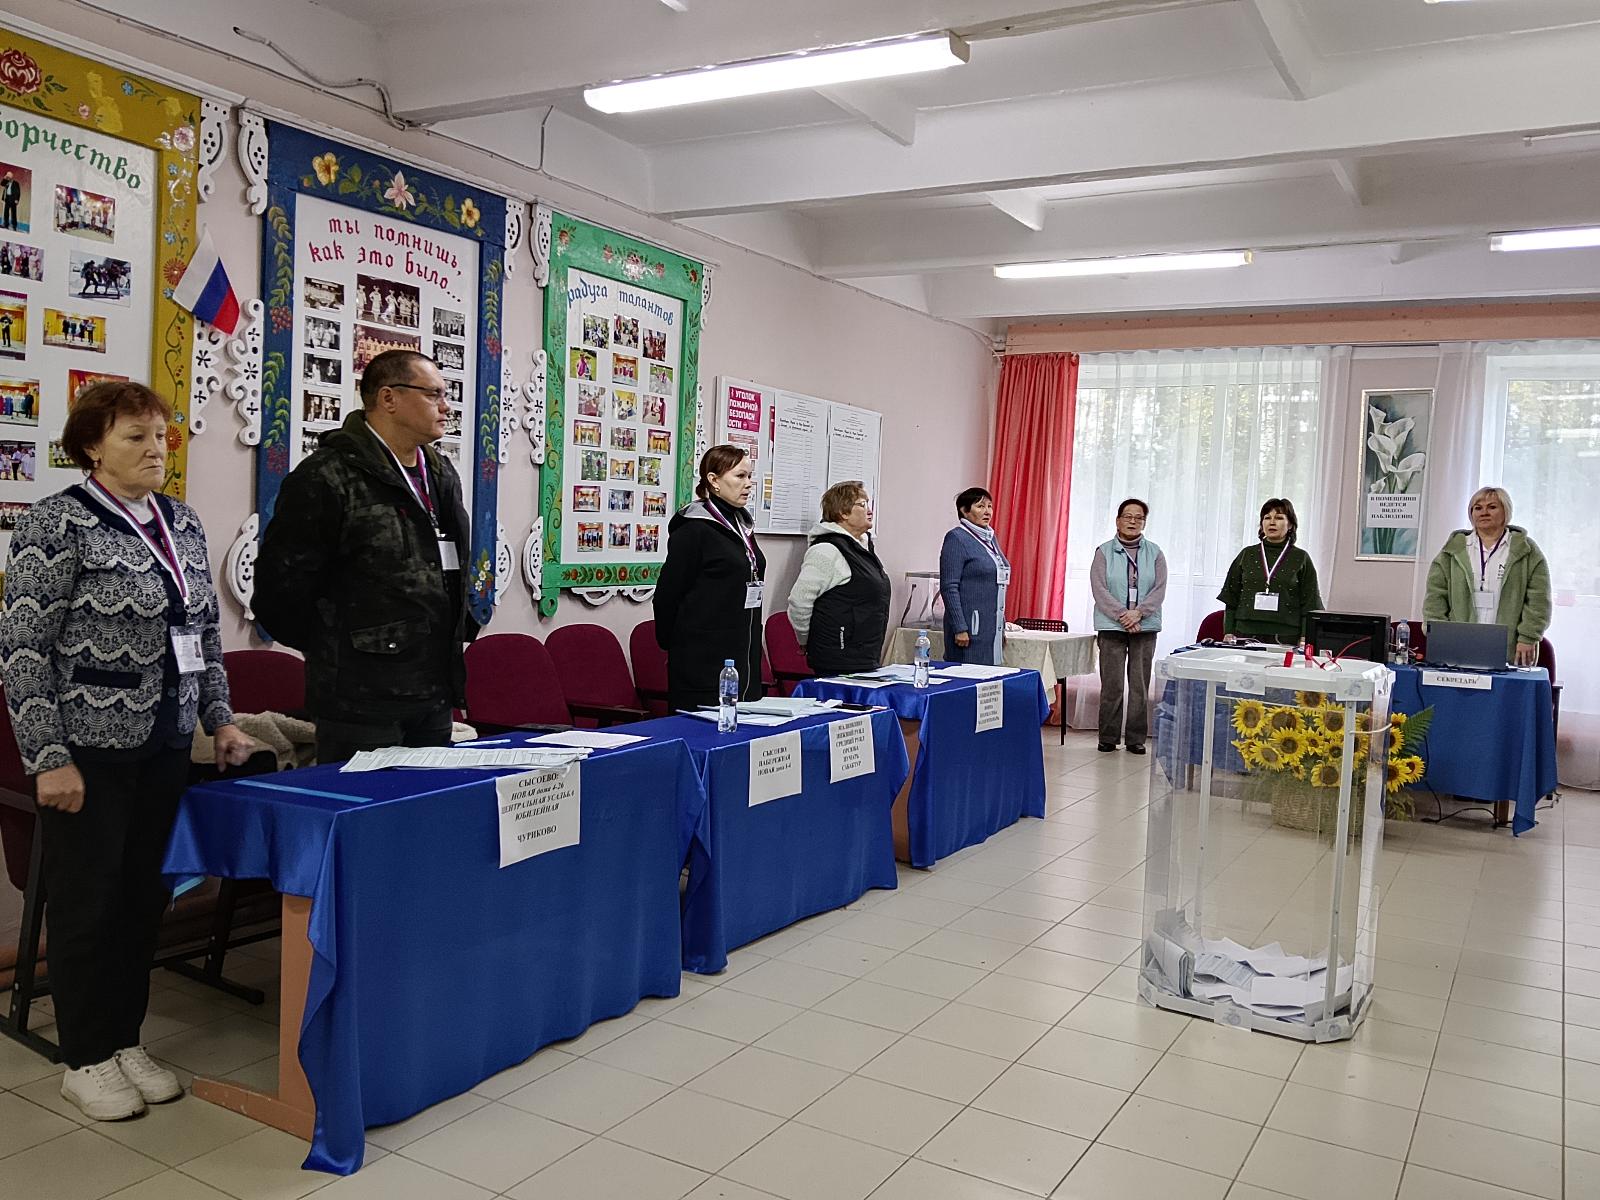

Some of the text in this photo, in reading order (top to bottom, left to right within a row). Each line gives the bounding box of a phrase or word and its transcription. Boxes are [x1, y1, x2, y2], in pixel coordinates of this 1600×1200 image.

[0, 112, 141, 189] орчество
[308, 239, 345, 263] как
[357, 246, 394, 268] это
[329, 217, 462, 277] ты помнишь,
[618, 290, 674, 326] талантов
[735, 389, 756, 402] УГОЛОК
[728, 398, 759, 412] ПОЖАРНОЙ
[728, 408, 756, 422] БЕЗОПАСН
[1436, 676, 1477, 685] СЕКРЕТАРЬ
[518, 772, 560, 788] СЫСОЕВО:
[510, 788, 536, 801] НОВАЯ
[514, 802, 560, 821] ЮБИЛЕЙНАЯ
[517, 824, 557, 843] ЧУРИКОВО
